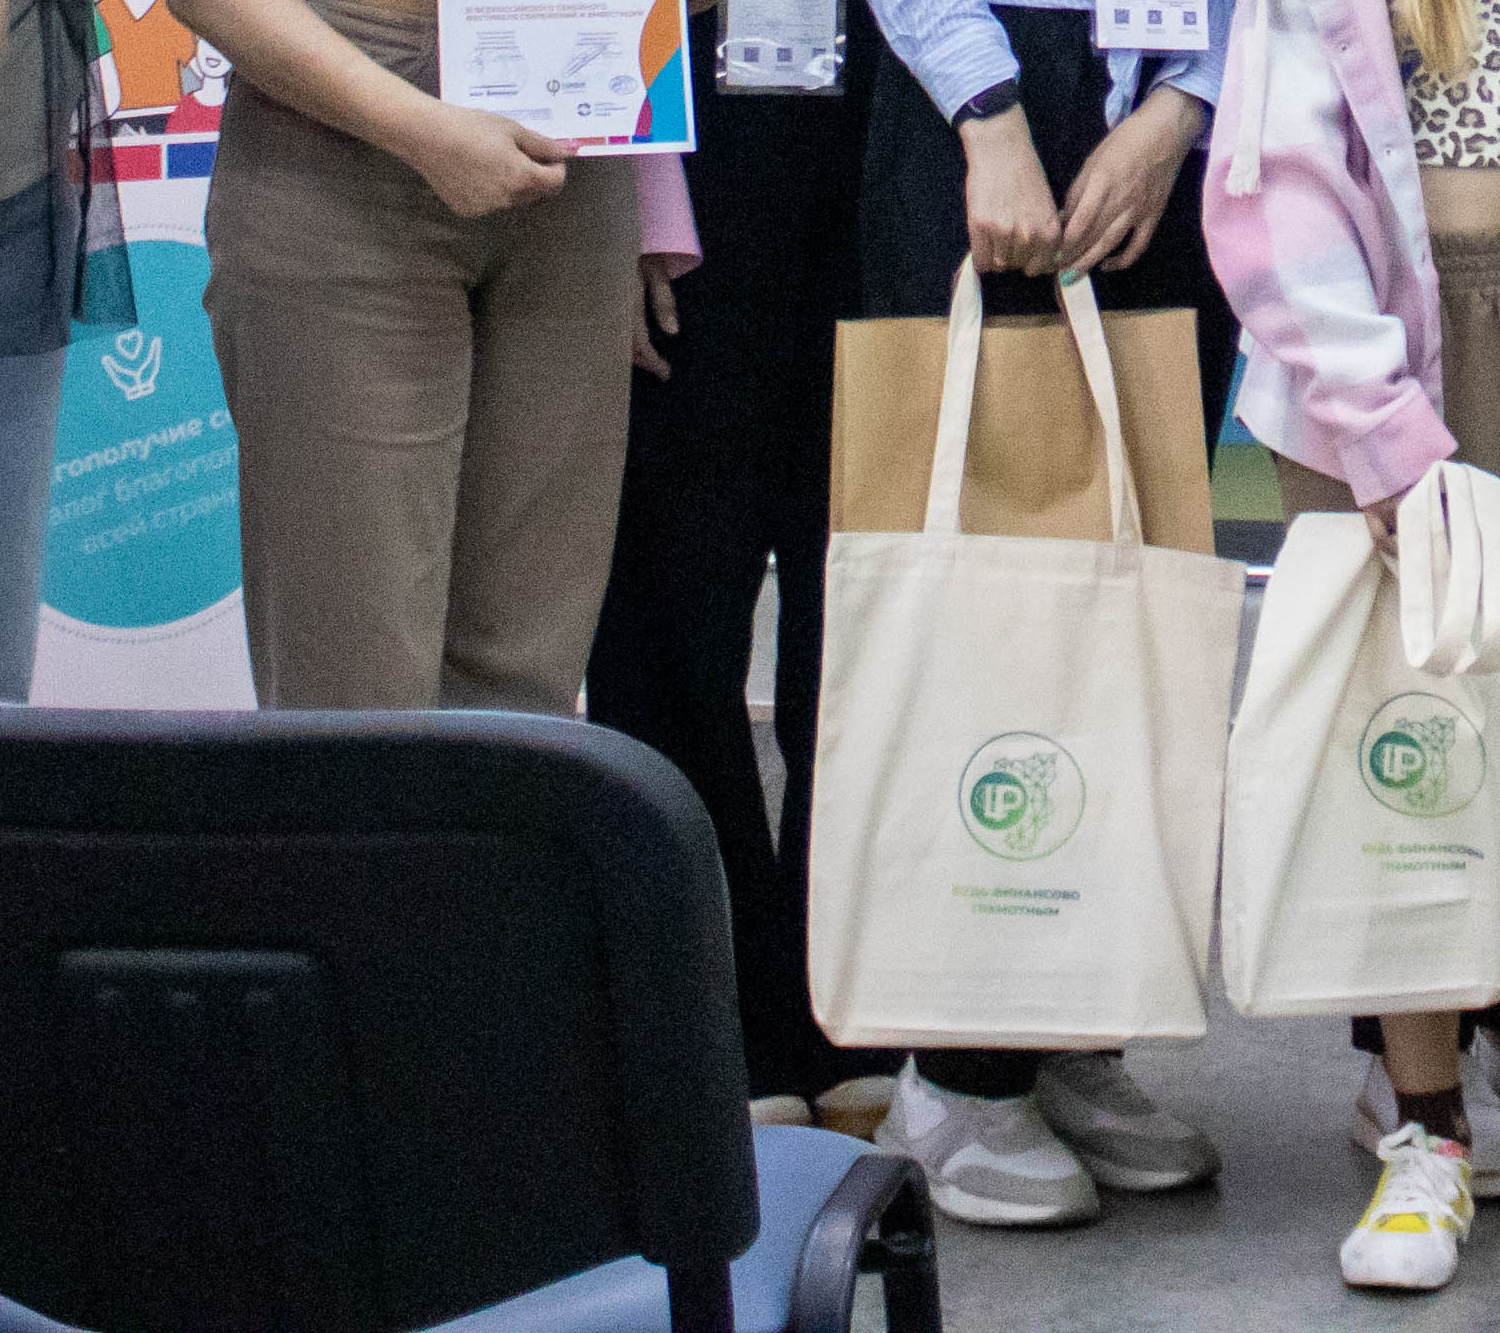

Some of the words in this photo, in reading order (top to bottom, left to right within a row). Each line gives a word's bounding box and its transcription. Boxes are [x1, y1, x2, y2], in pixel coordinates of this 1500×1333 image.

[1396, 843, 1485, 860] ФИНАНСОВО
[1380, 860, 1467, 871] ГРАМОТНЫМ
[991, 887, 1081, 901] ФИНАНСОВО
[971, 903, 1060, 916] ГРАМОТНЫМ
